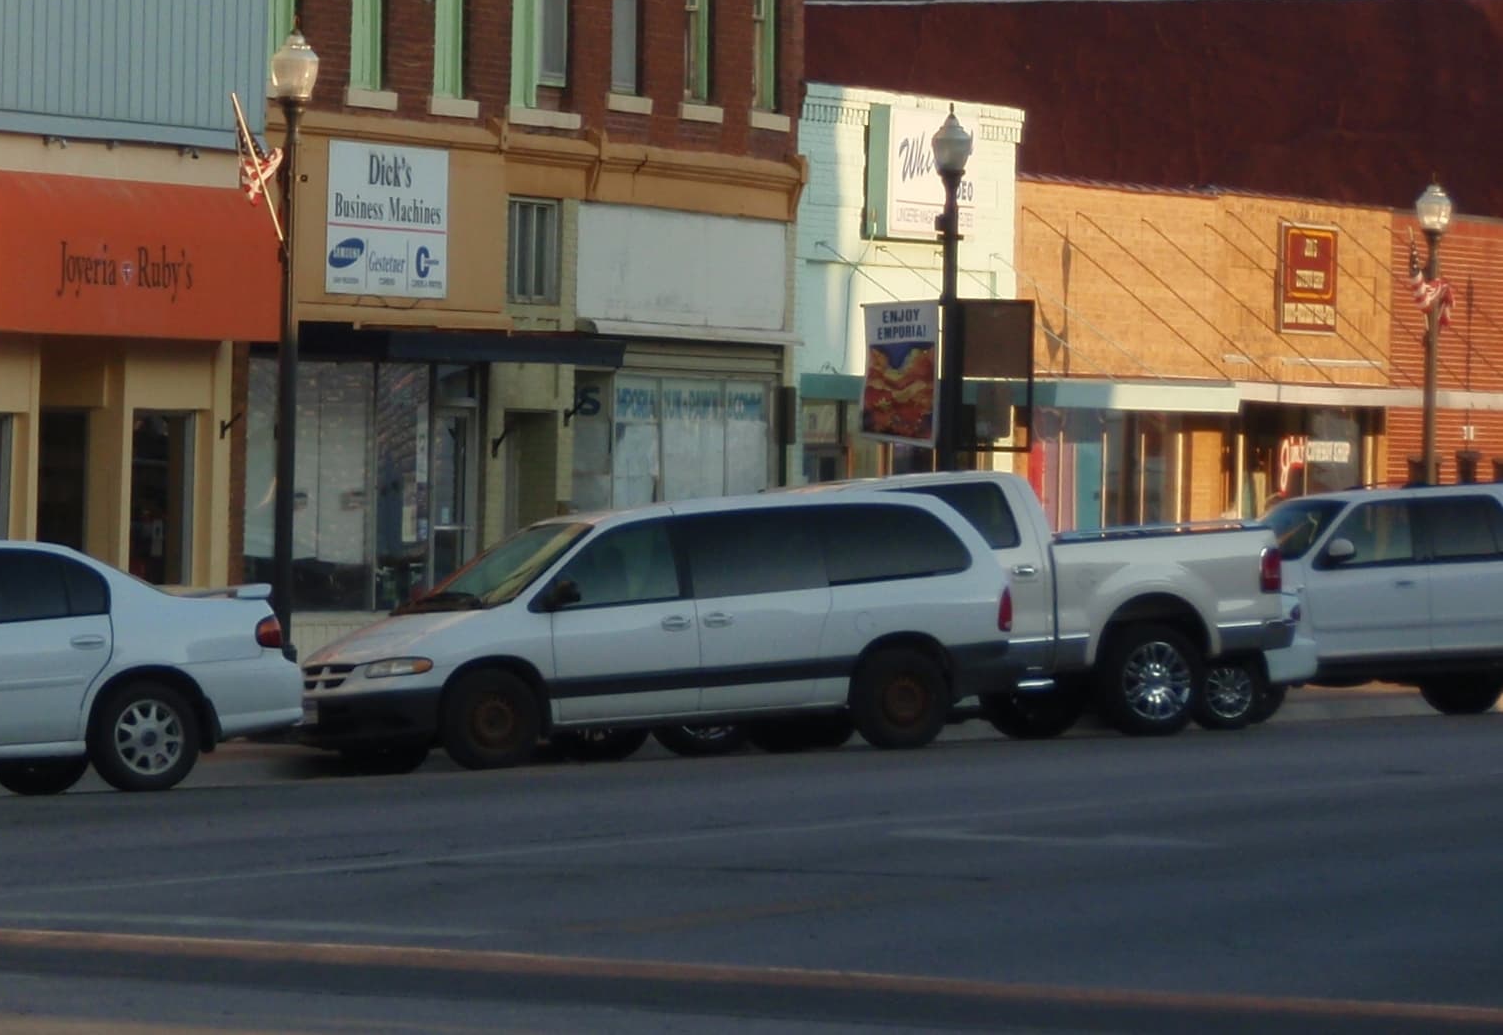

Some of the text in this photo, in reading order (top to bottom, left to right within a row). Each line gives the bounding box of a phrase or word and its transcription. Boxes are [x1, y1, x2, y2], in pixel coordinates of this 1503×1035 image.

[368, 153, 412, 188] Dick's
[334, 192, 441, 225] Business Machines
[56, 241, 194, 303] Joyeria Ruby's
[877, 325, 927, 340] EMPORIA!
[882, 308, 920, 324] ENJOY
